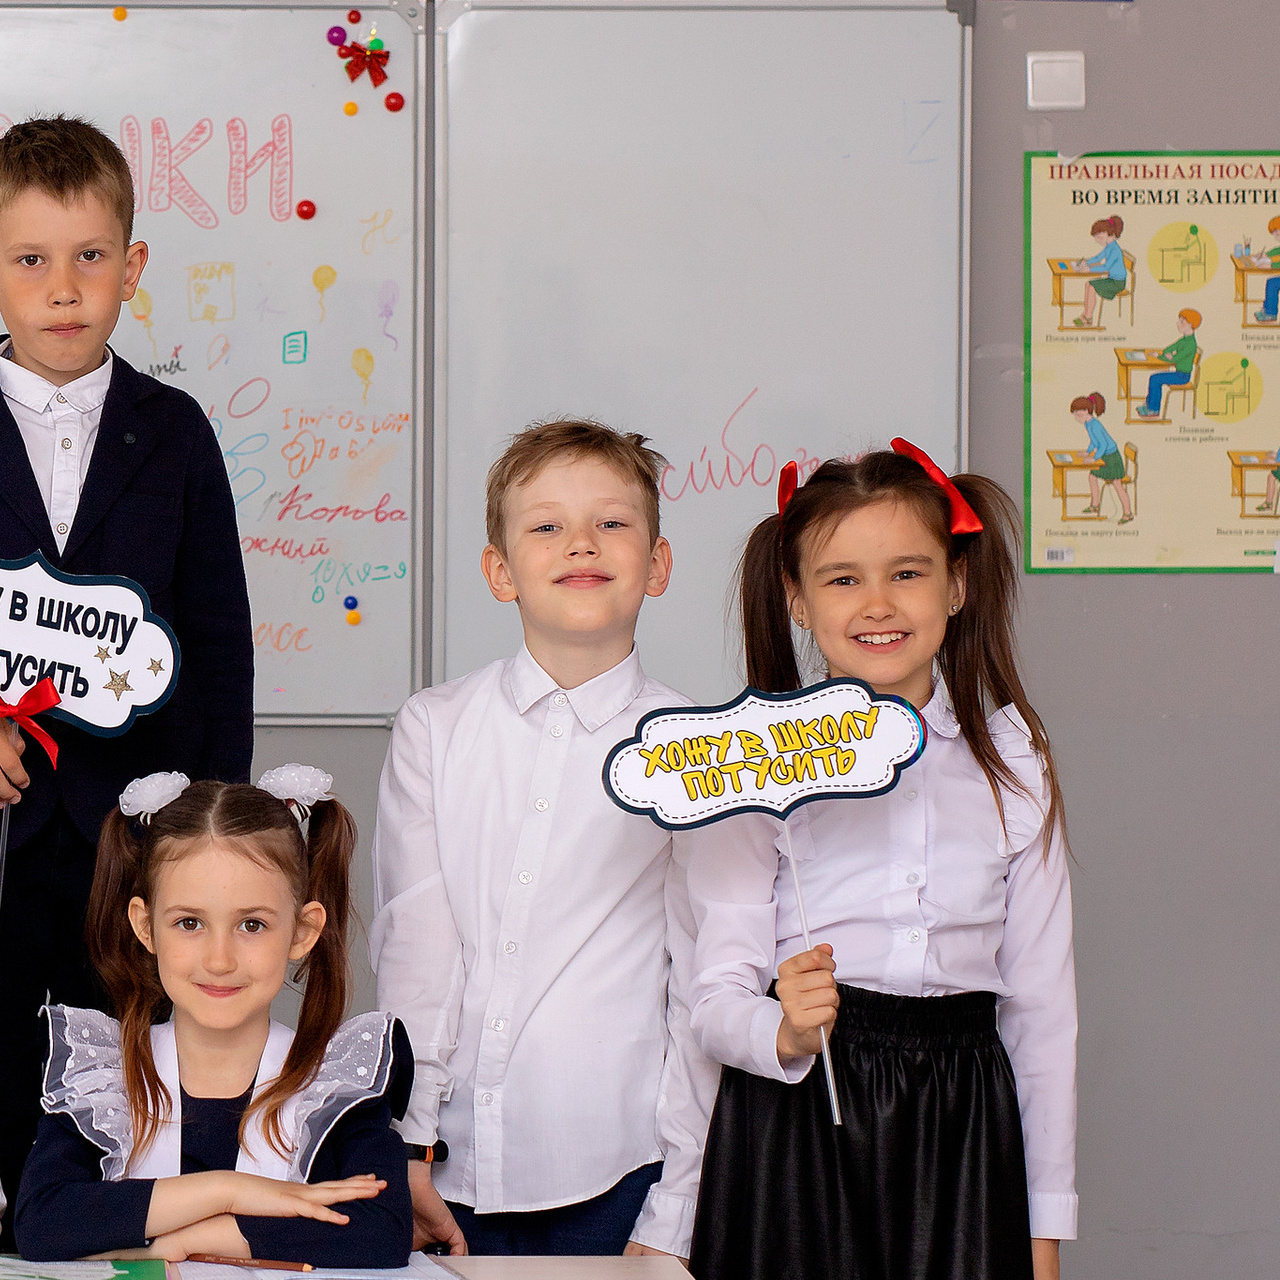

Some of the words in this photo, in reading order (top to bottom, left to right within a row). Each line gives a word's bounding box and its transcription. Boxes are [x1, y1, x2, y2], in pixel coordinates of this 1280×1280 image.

[1049, 163, 1202, 180] ПРАВИЛЬНАЯ
[1072, 189, 1099, 205] ВО
[1106, 189, 1179, 205] ВРЕМЯ
[9, 590, 29, 621] В
[36, 597, 138, 655] ШКОЛУ
[639, 731, 733, 777] ХОЖУ
[736, 730, 767, 759] В
[768, 706, 879, 753] ШКОЛУ
[681, 745, 856, 801] ПОТУСИТЬ
